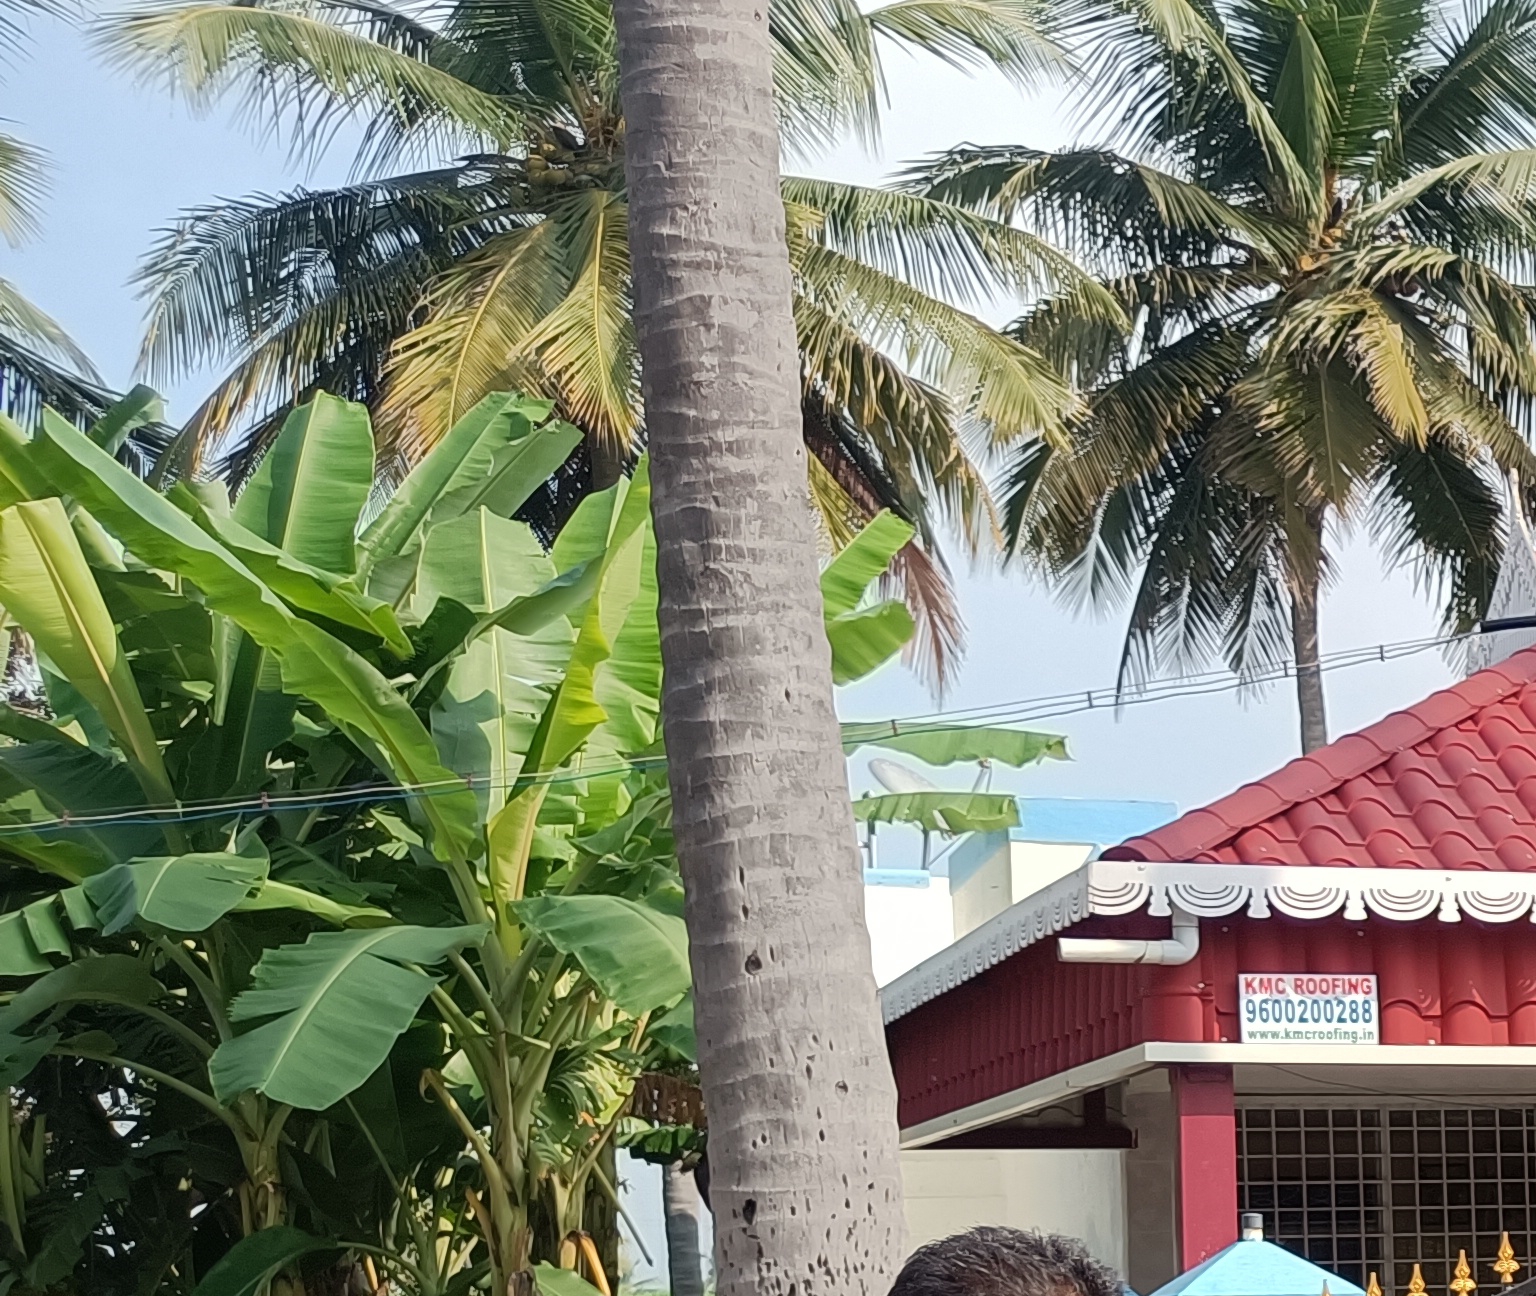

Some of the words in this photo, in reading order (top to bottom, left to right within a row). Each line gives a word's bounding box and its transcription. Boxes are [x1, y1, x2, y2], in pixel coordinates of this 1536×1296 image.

[1244, 977, 1287, 995] KMC
[1293, 977, 1373, 995] ROOFING
[1245, 999, 1373, 1024] 9600200288
[1247, 1027, 1375, 1043] www.kmcroofing.in
